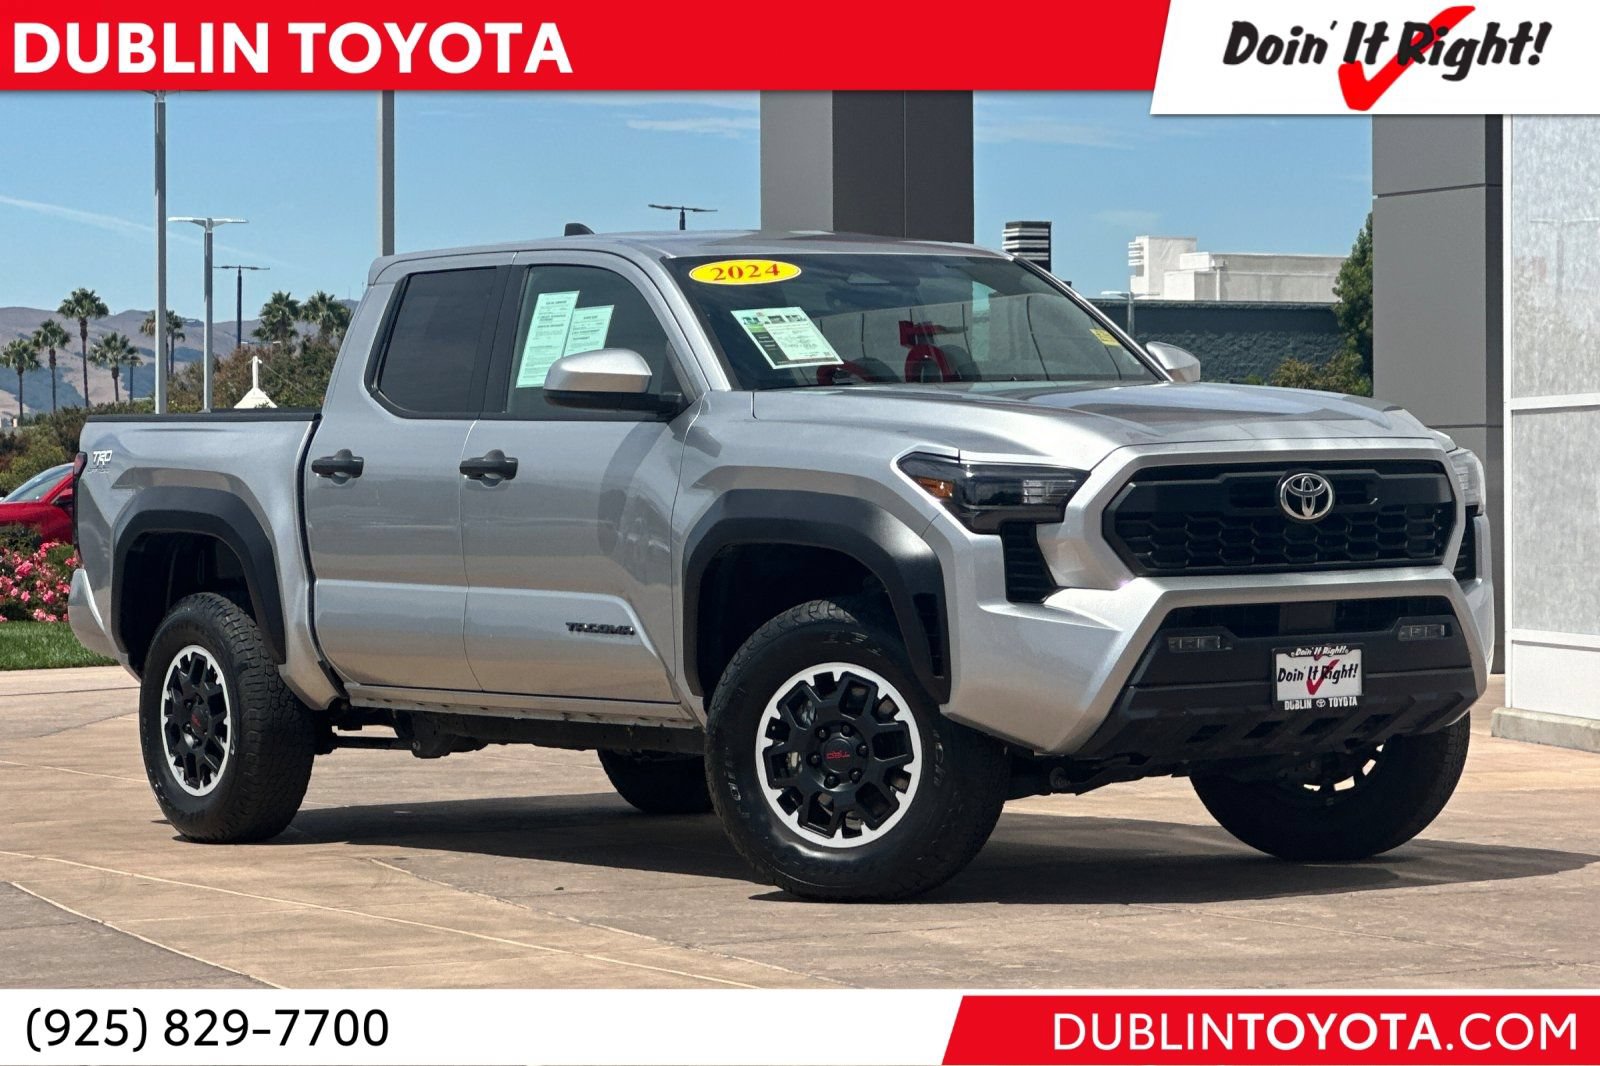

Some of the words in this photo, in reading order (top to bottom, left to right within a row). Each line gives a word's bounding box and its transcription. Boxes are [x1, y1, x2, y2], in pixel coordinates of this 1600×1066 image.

[710, 263, 781, 281] 2024
[92, 449, 113, 466] TRD
[1277, 666, 1306, 683] Doin'
[1308, 665, 1319, 681] It
[1320, 663, 1358, 684] Right!
[1284, 699, 1312, 711] DUBLIN
[1328, 696, 1357, 708] TOYOTA
